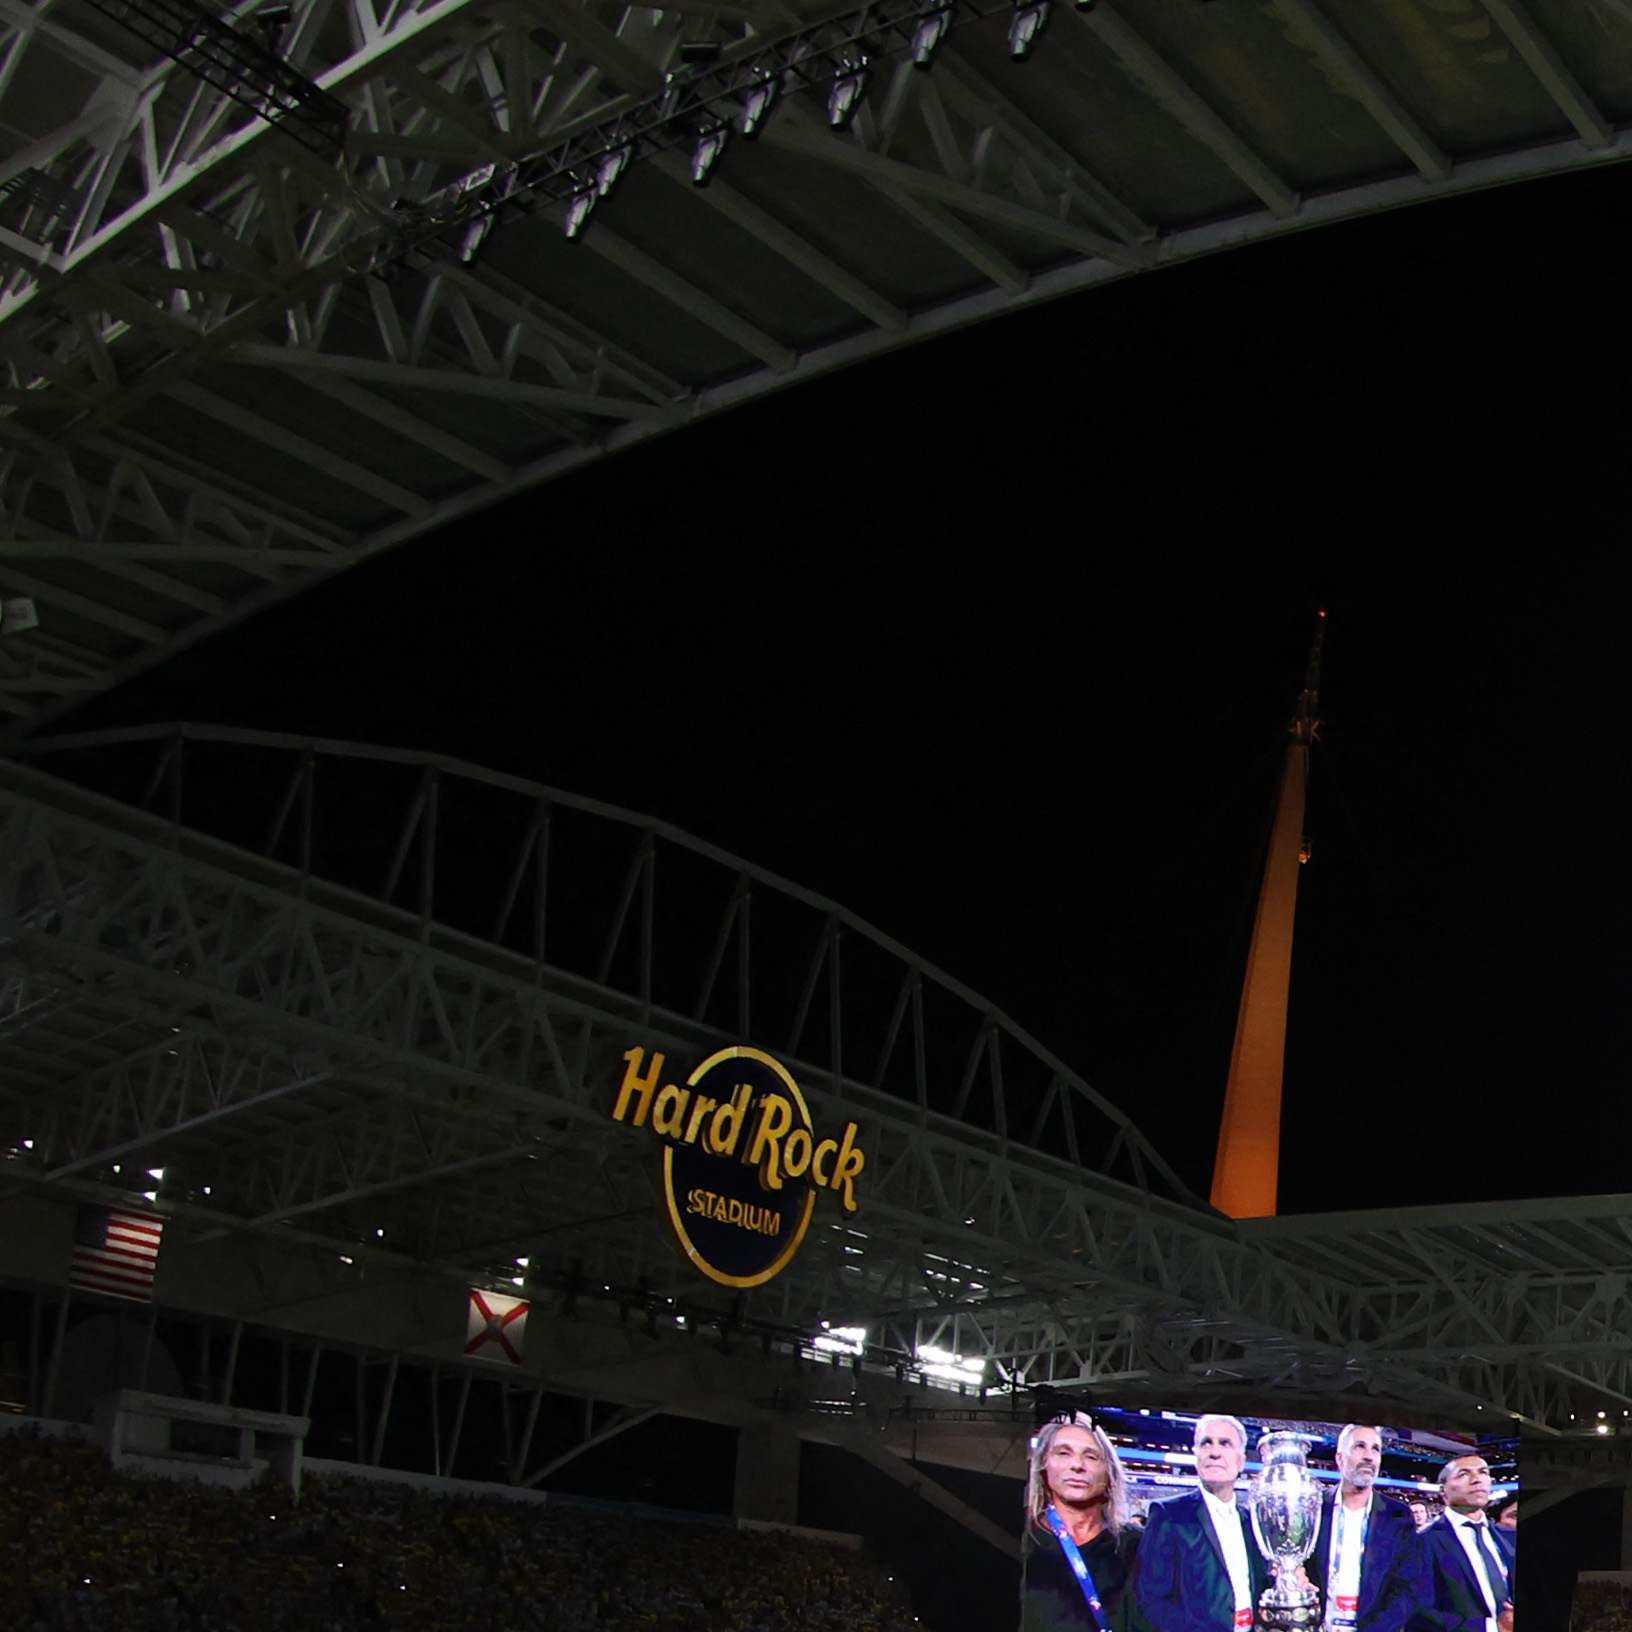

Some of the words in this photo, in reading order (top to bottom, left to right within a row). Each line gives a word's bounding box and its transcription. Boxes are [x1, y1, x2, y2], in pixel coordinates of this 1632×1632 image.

[612, 1046, 751, 1156] Hard
[749, 1093, 865, 1212] Rock
[687, 1188, 781, 1236] STADIUM
